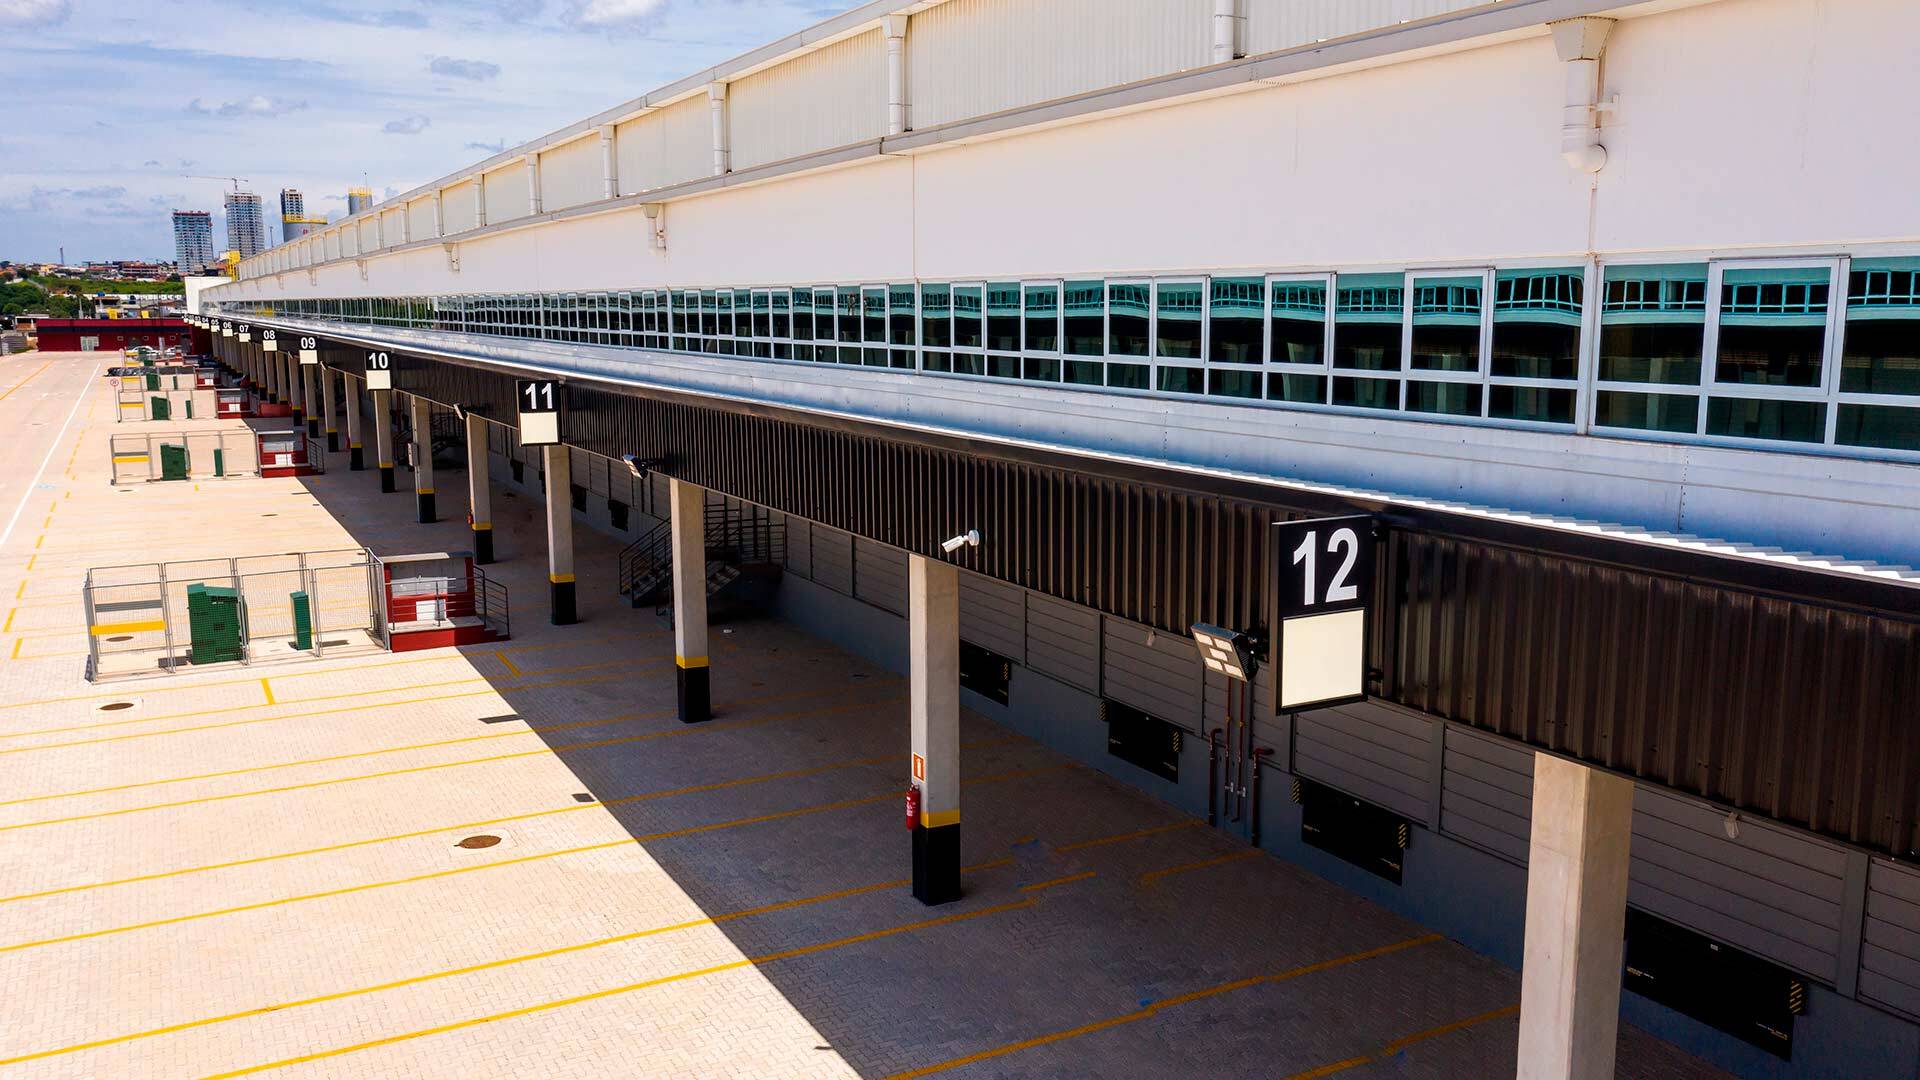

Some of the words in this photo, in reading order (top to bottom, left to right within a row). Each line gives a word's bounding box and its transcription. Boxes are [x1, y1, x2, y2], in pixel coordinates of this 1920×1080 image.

[222, 321, 232, 329] 06
[239, 325, 249, 333] 07
[263, 330, 276, 341] 08
[300, 337, 316, 349] 09
[368, 352, 389, 370] 10
[525, 383, 554, 410] 11
[1293, 527, 1359, 606] 12
